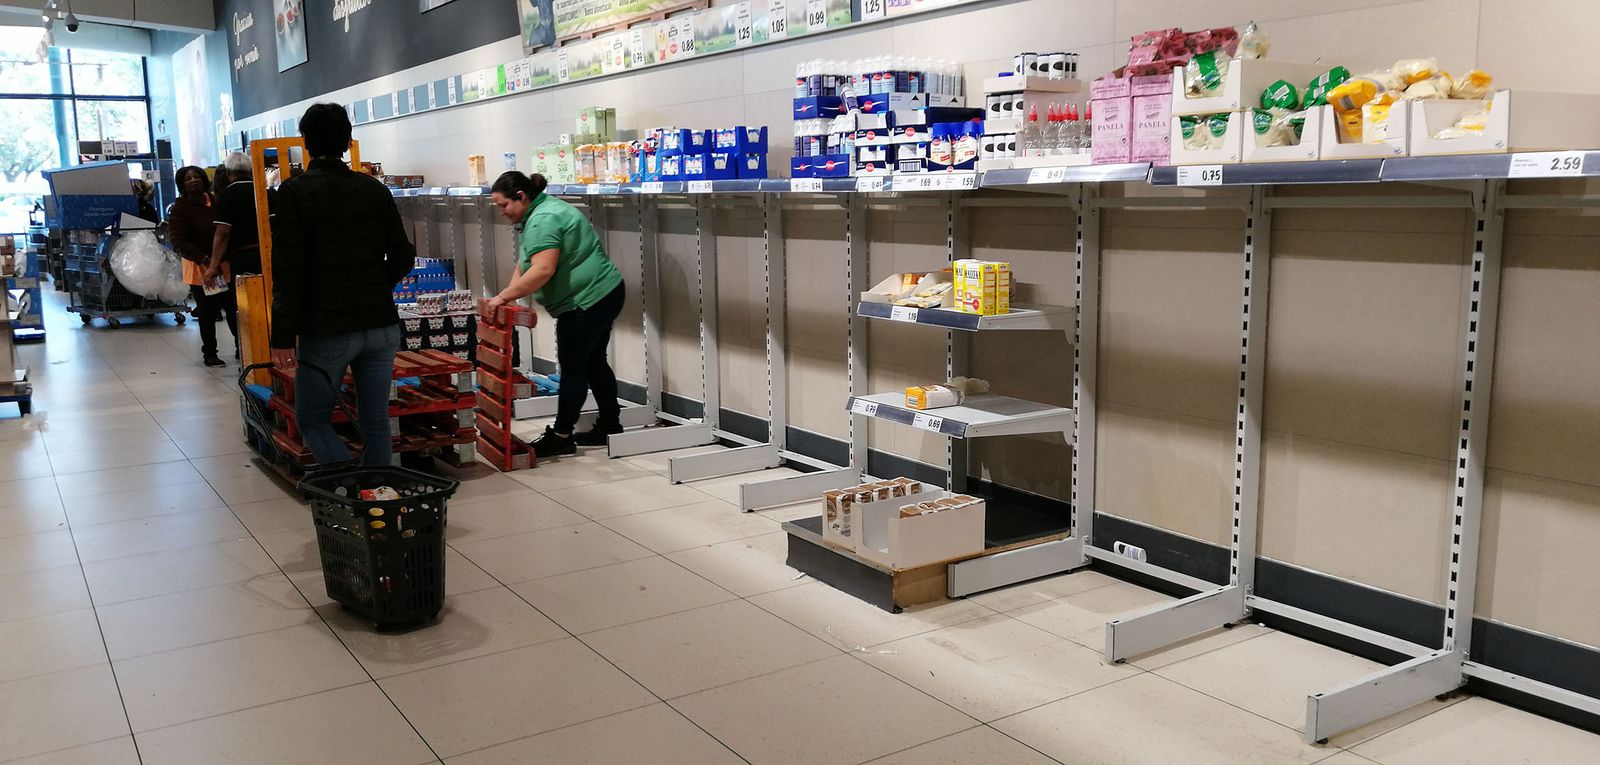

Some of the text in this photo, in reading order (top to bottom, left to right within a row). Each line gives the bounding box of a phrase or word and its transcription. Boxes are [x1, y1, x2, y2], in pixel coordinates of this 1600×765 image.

[865, 0, 880, 14] 1.25
[809, 11, 825, 26] 0.99
[771, 19, 784, 34] 1.05
[738, 27, 751, 40] 1.25
[1097, 122, 1124, 131] PANELA
[1138, 120, 1166, 129] PANELA
[1550, 157, 1582, 171] 2.59
[1202, 170, 1221, 181] 0.75
[928, 418, 940, 430] 0.69
